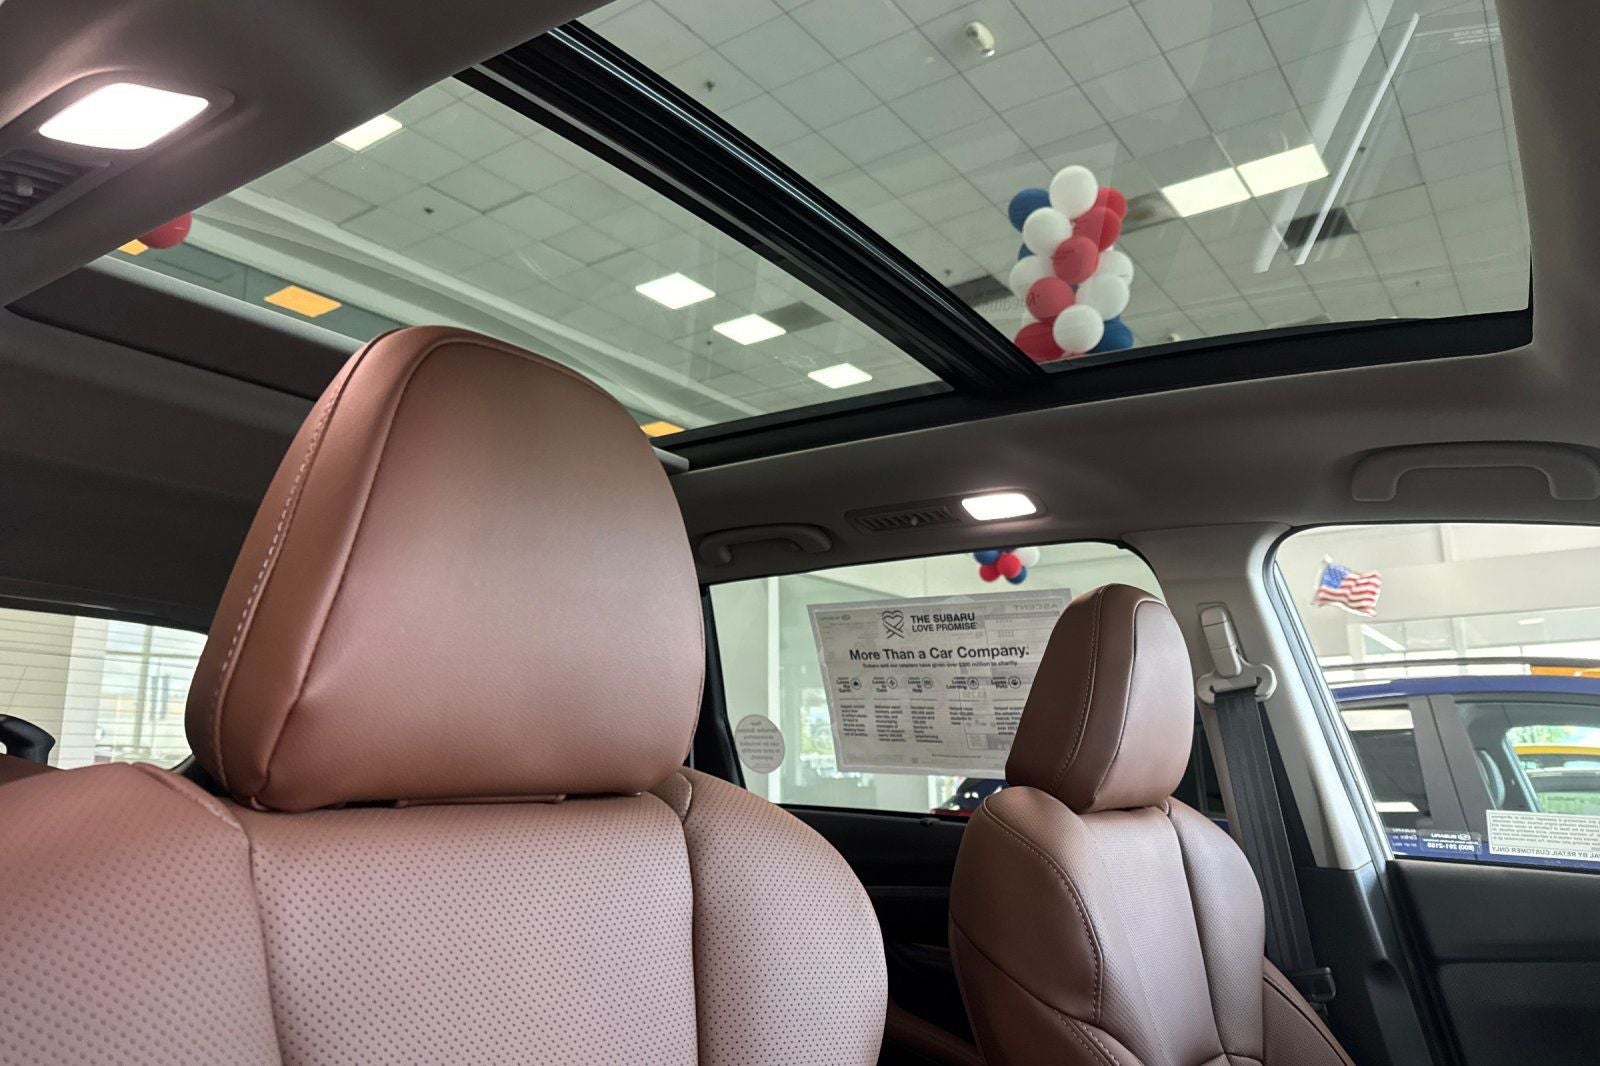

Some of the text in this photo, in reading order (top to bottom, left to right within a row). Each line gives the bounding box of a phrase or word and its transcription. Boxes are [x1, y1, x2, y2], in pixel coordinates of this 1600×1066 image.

[910, 611, 976, 624] THE SUBARU
[911, 621, 977, 633] LOVE PROMISE
[849, 648, 881, 661] More
[884, 647, 915, 660] Than
[918, 649, 926, 659] a
[929, 646, 953, 659] Car
